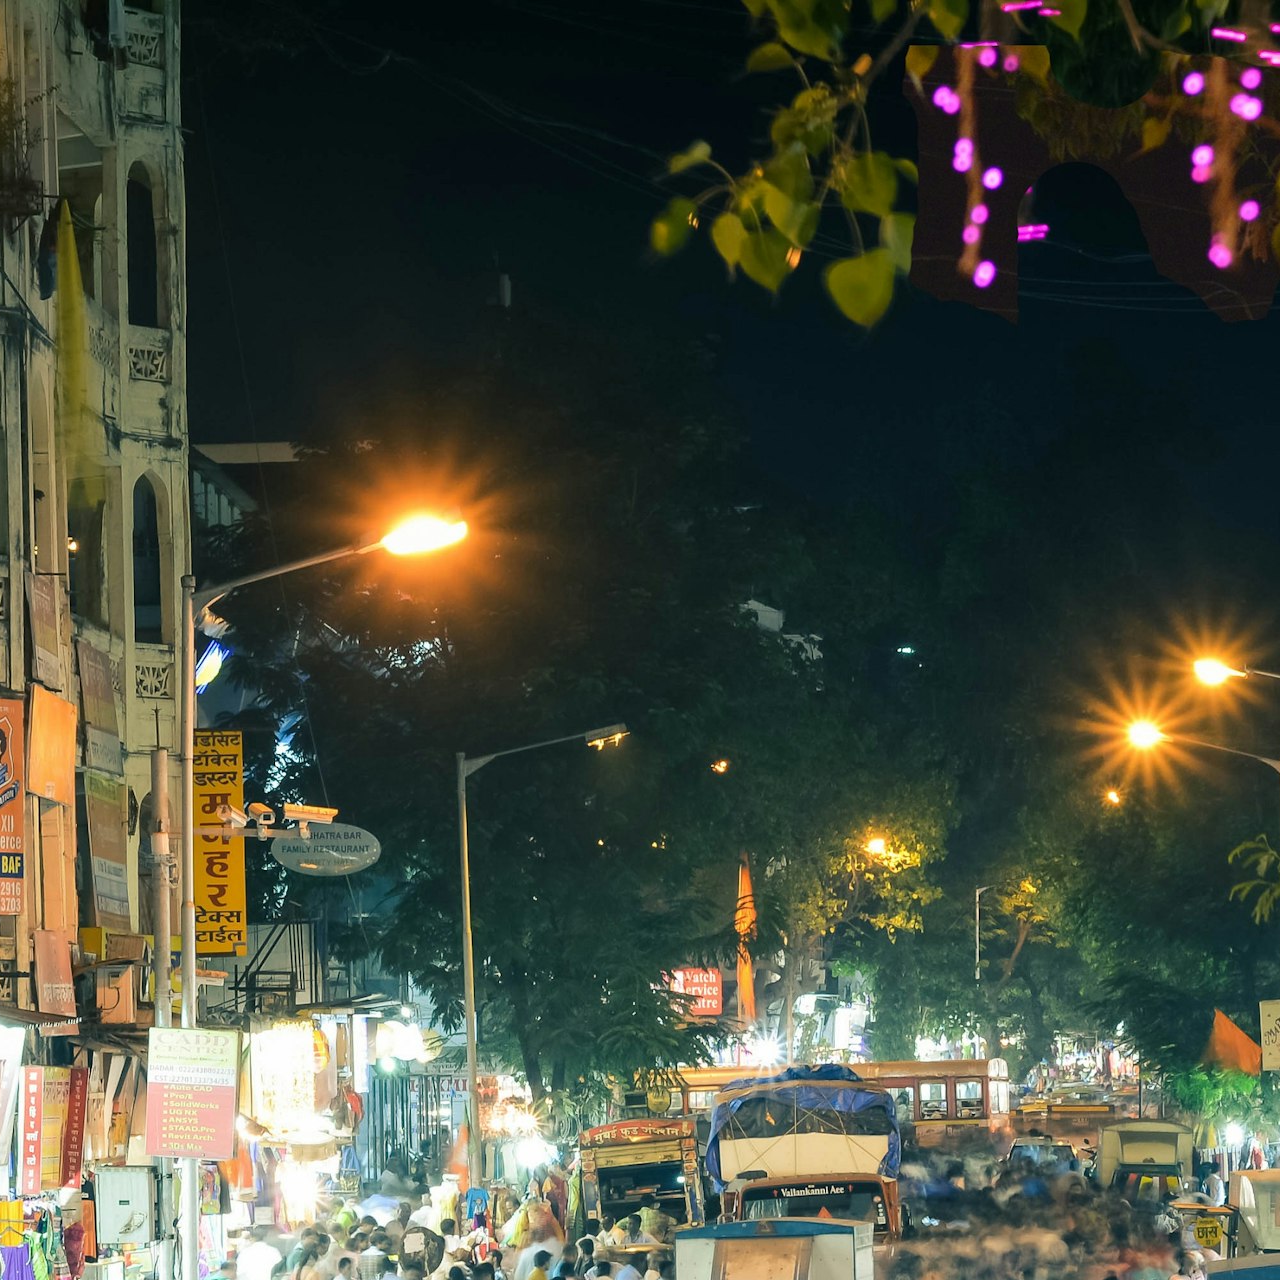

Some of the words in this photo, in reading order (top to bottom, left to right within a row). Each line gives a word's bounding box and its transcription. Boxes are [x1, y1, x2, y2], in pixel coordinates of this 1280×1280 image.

[194, 771, 238, 788] डस्टर
[1, 815, 14, 833] XII
[342, 831, 362, 840] BAR
[281, 845, 311, 854] FAMILY
[313, 845, 370, 854] RESTAURANT
[2, 857, 21, 874] BAF
[195, 907, 242, 923] टेक्स
[196, 925, 242, 943] टाईल
[686, 985, 719, 996] ervice
[169, 1100, 219, 1109] SolidWorks
[168, 1125, 216, 1133] STAAD.Pro
